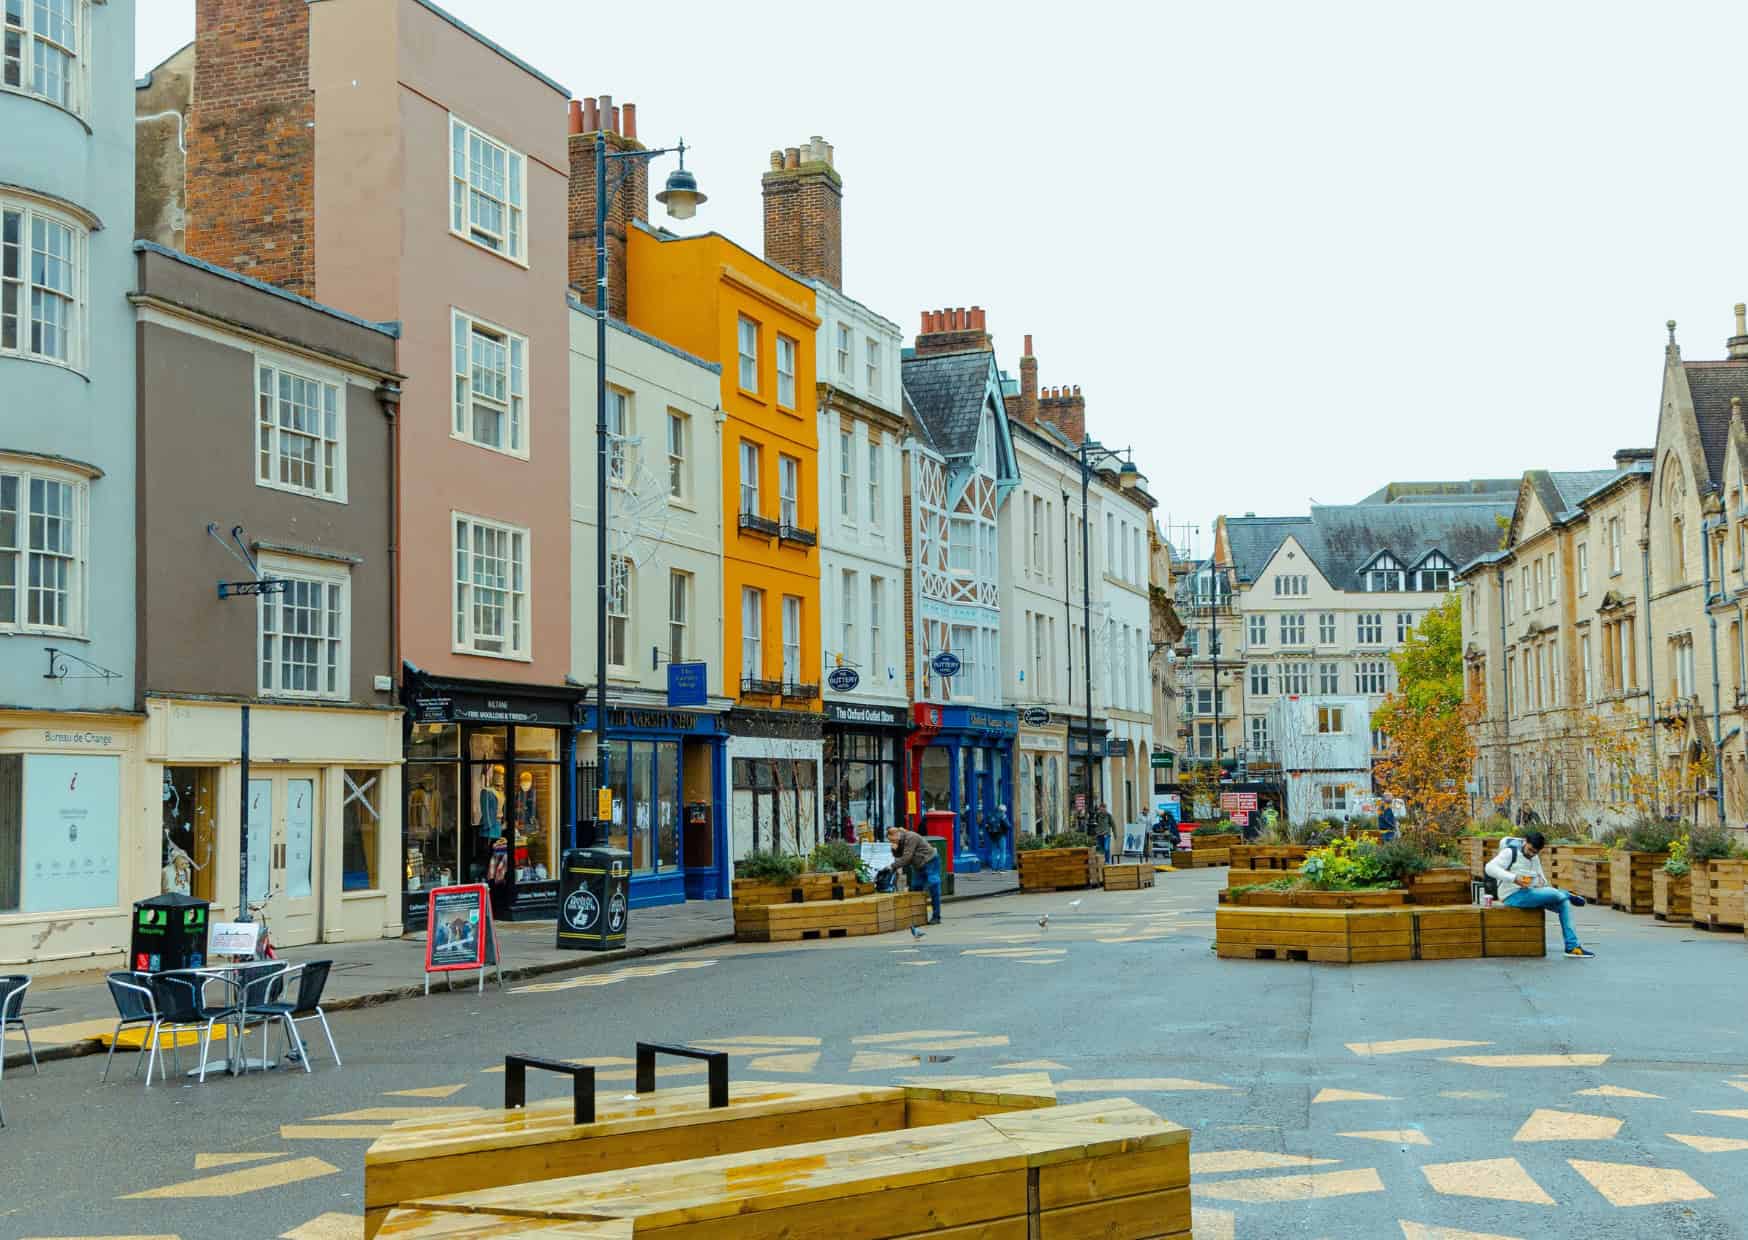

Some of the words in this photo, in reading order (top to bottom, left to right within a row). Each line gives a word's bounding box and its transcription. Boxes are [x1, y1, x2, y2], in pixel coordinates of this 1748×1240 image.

[828, 676, 858, 685] BUTTERY
[609, 710, 628, 727] THE
[631, 710, 670, 729] VARSITY
[673, 713, 698, 730] SHOP
[836, 706, 847, 720] The
[847, 708, 865, 721] Oxford
[865, 710, 881, 721] Outlet
[45, 731, 72, 742] Bureau
[73, 732, 83, 743] de
[85, 732, 113, 747] Change
